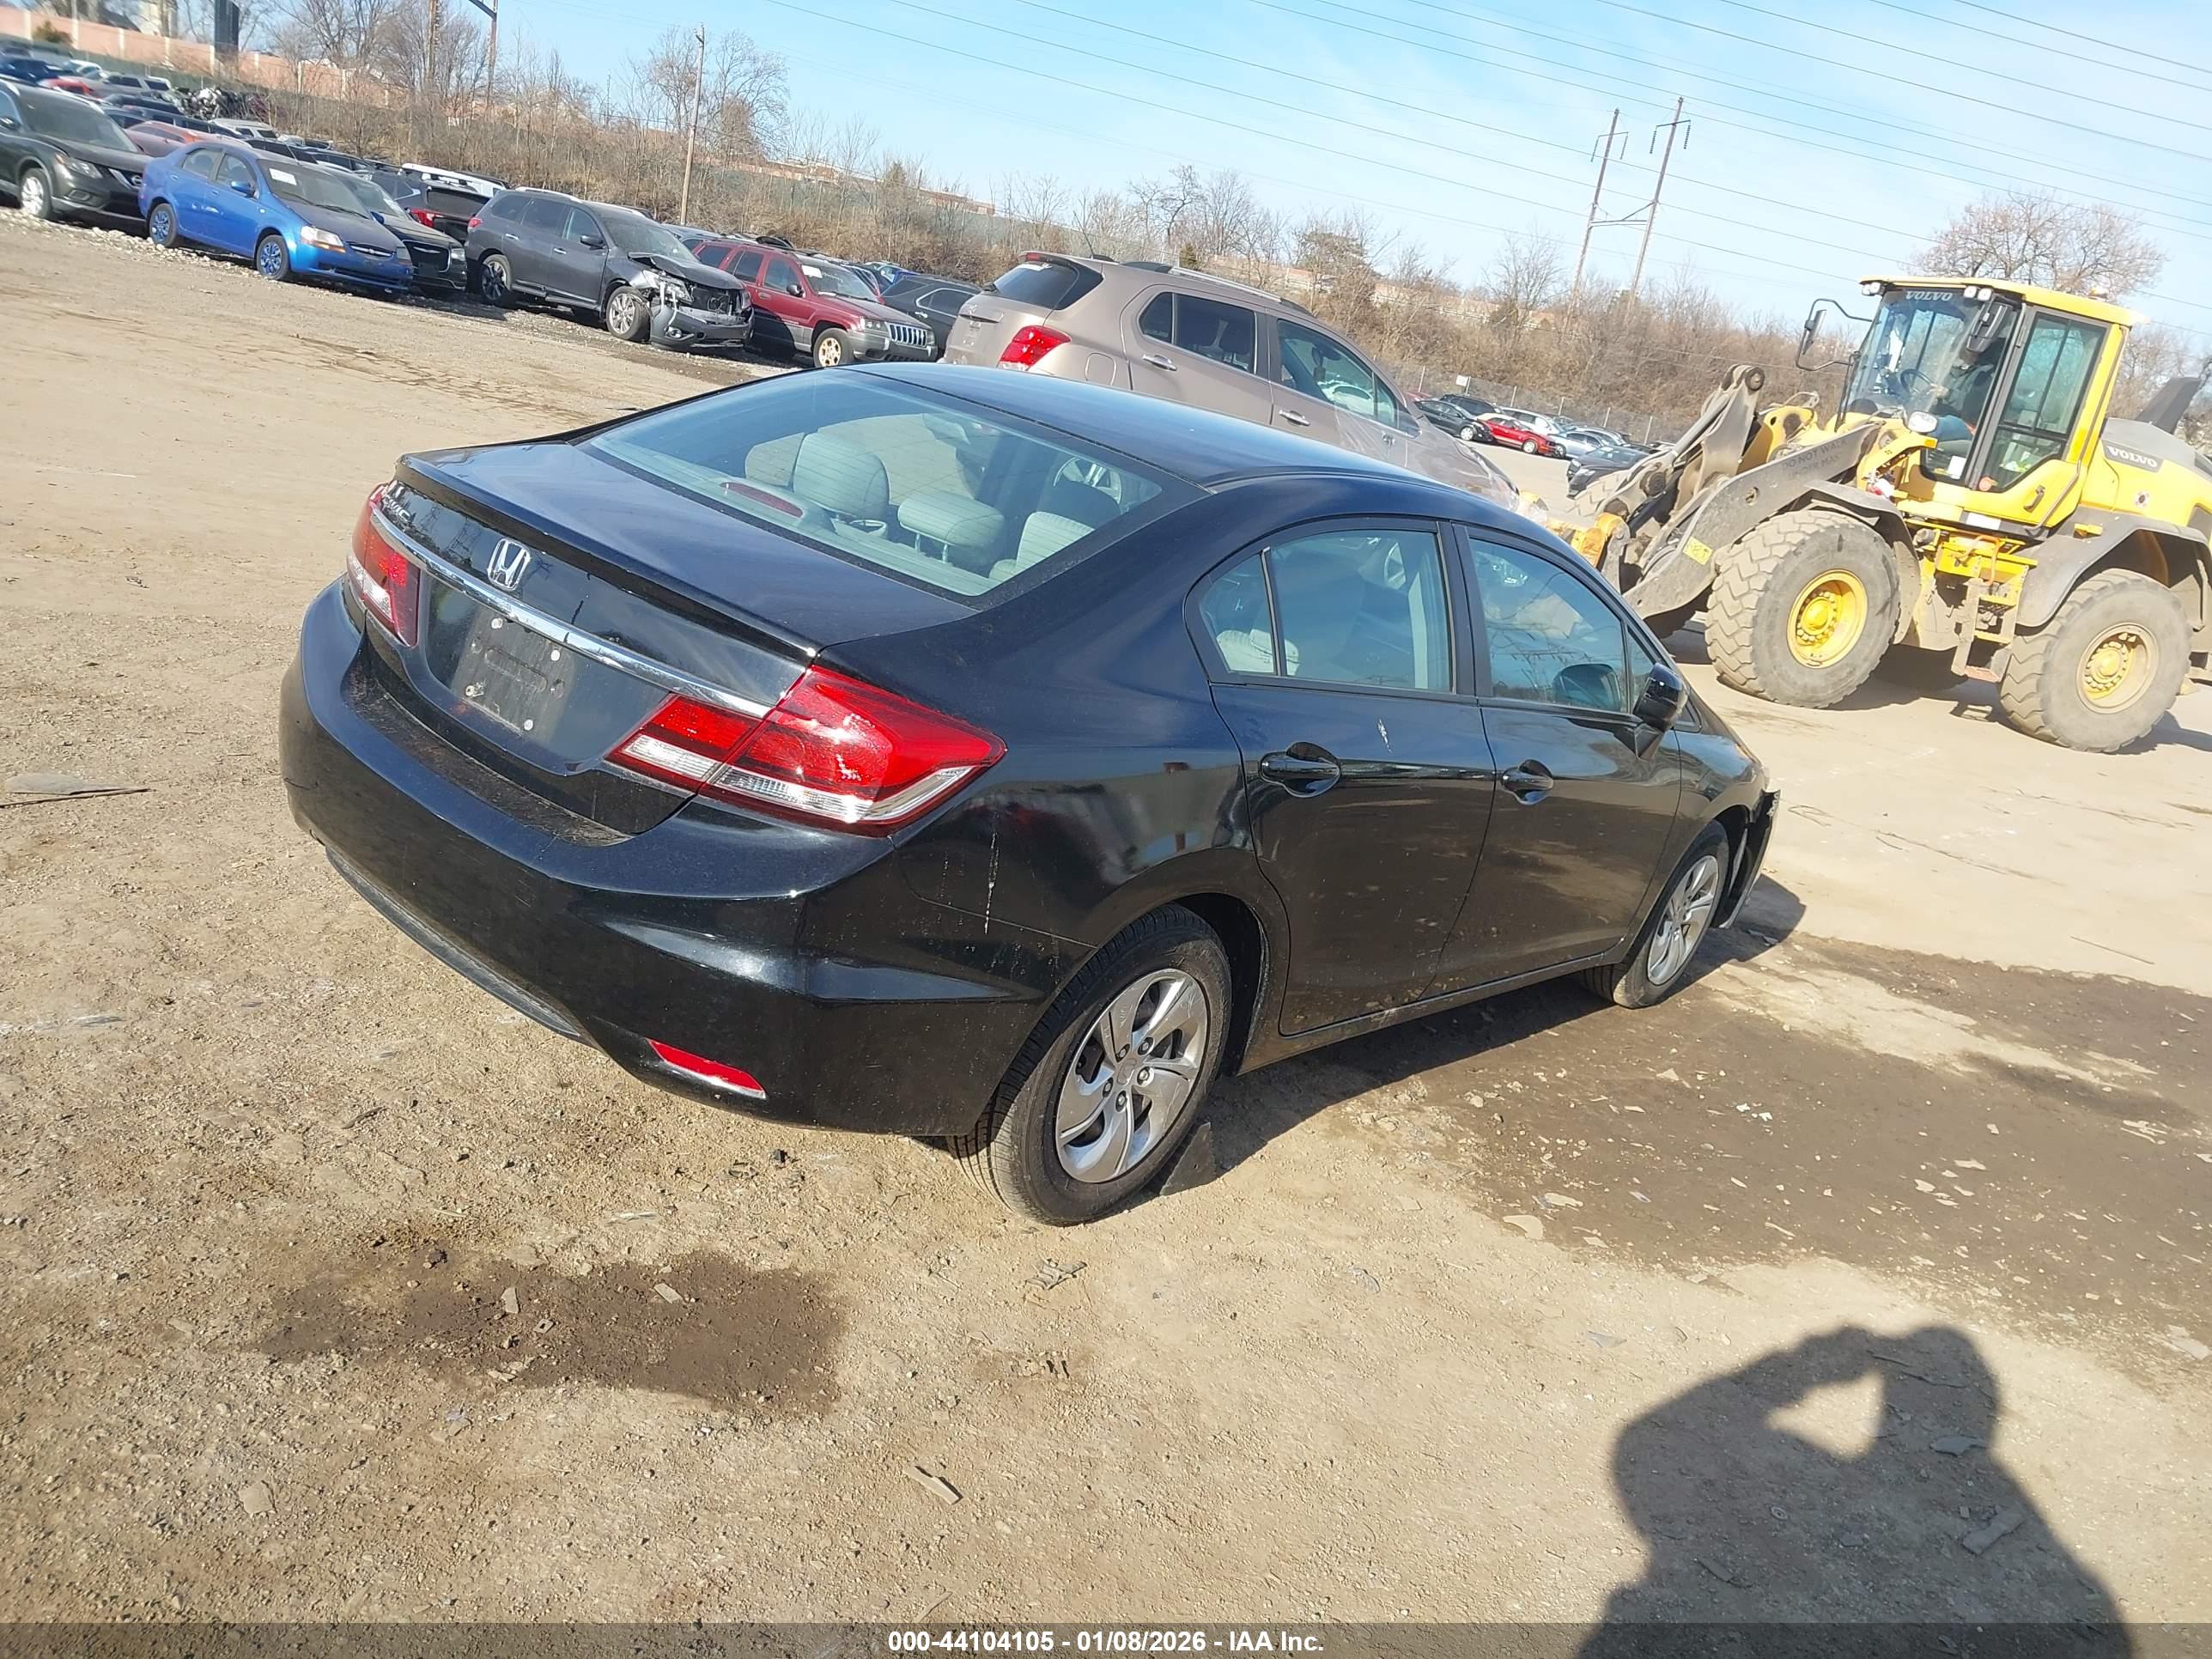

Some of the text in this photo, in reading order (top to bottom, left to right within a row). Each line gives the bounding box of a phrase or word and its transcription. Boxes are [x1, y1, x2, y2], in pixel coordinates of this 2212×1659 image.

[1906, 290, 1954, 301] VOLVO
[1798, 449, 1818, 465] NOT
[2106, 446, 2158, 468] VOLVO
